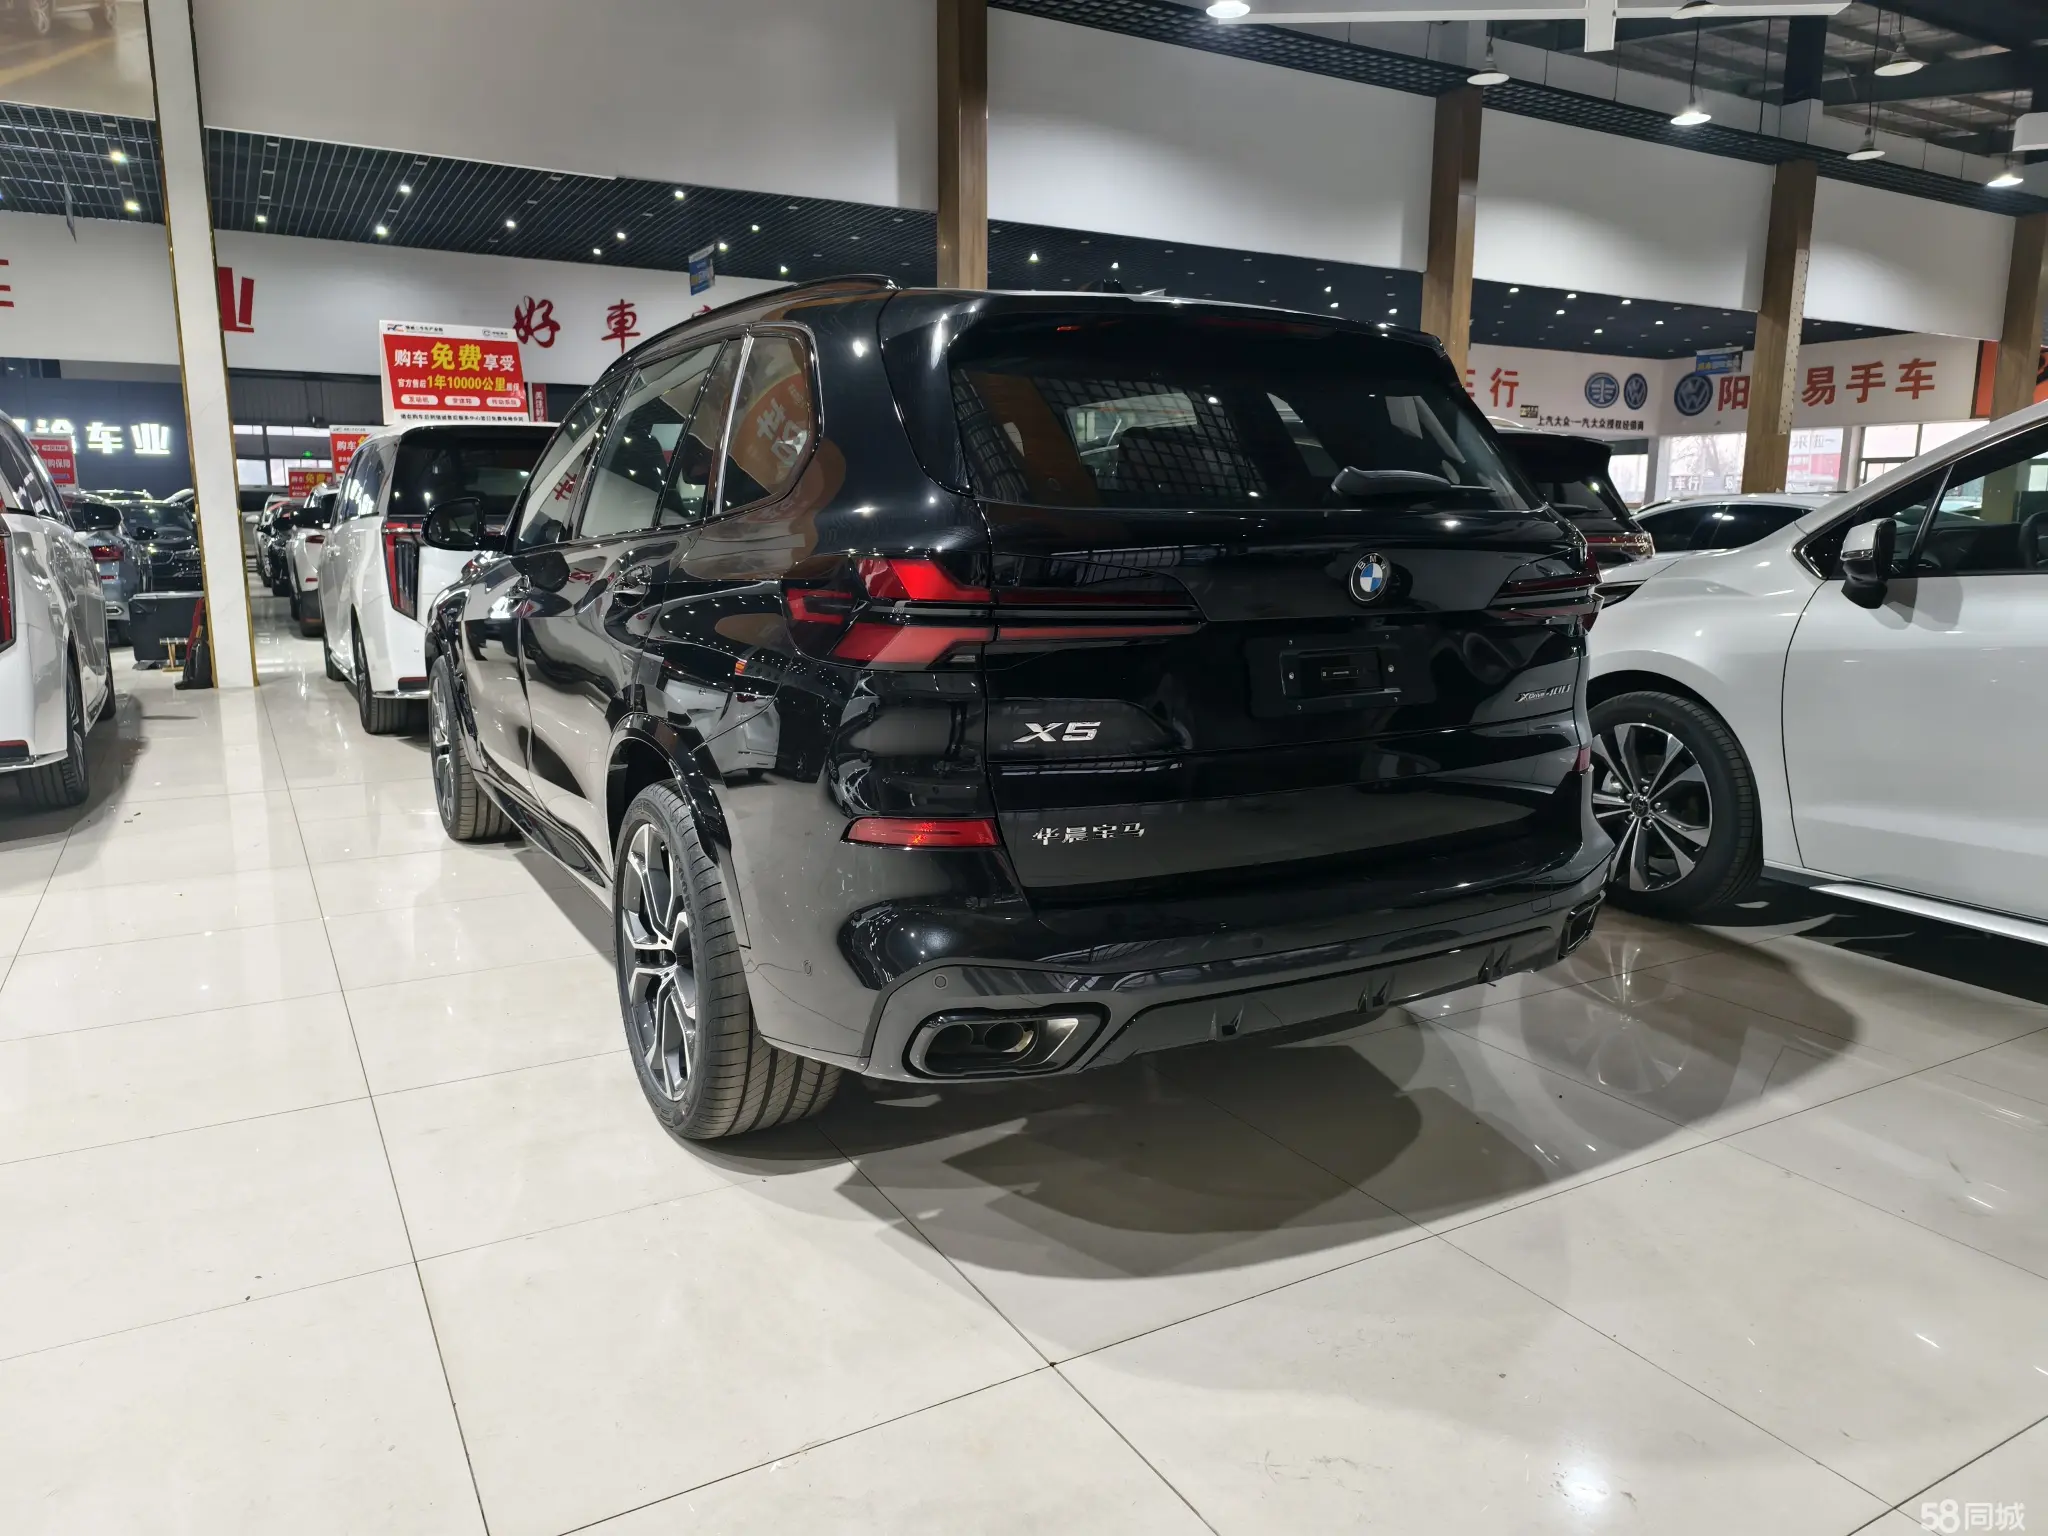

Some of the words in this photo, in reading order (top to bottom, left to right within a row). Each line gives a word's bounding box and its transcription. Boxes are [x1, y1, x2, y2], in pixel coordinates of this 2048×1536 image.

[394, 341, 515, 372] 购车免费享受
[1357, 554, 1387, 571] BMW
[1012, 721, 1101, 743] X5
[1032, 822, 1146, 846] 华晨宝马
